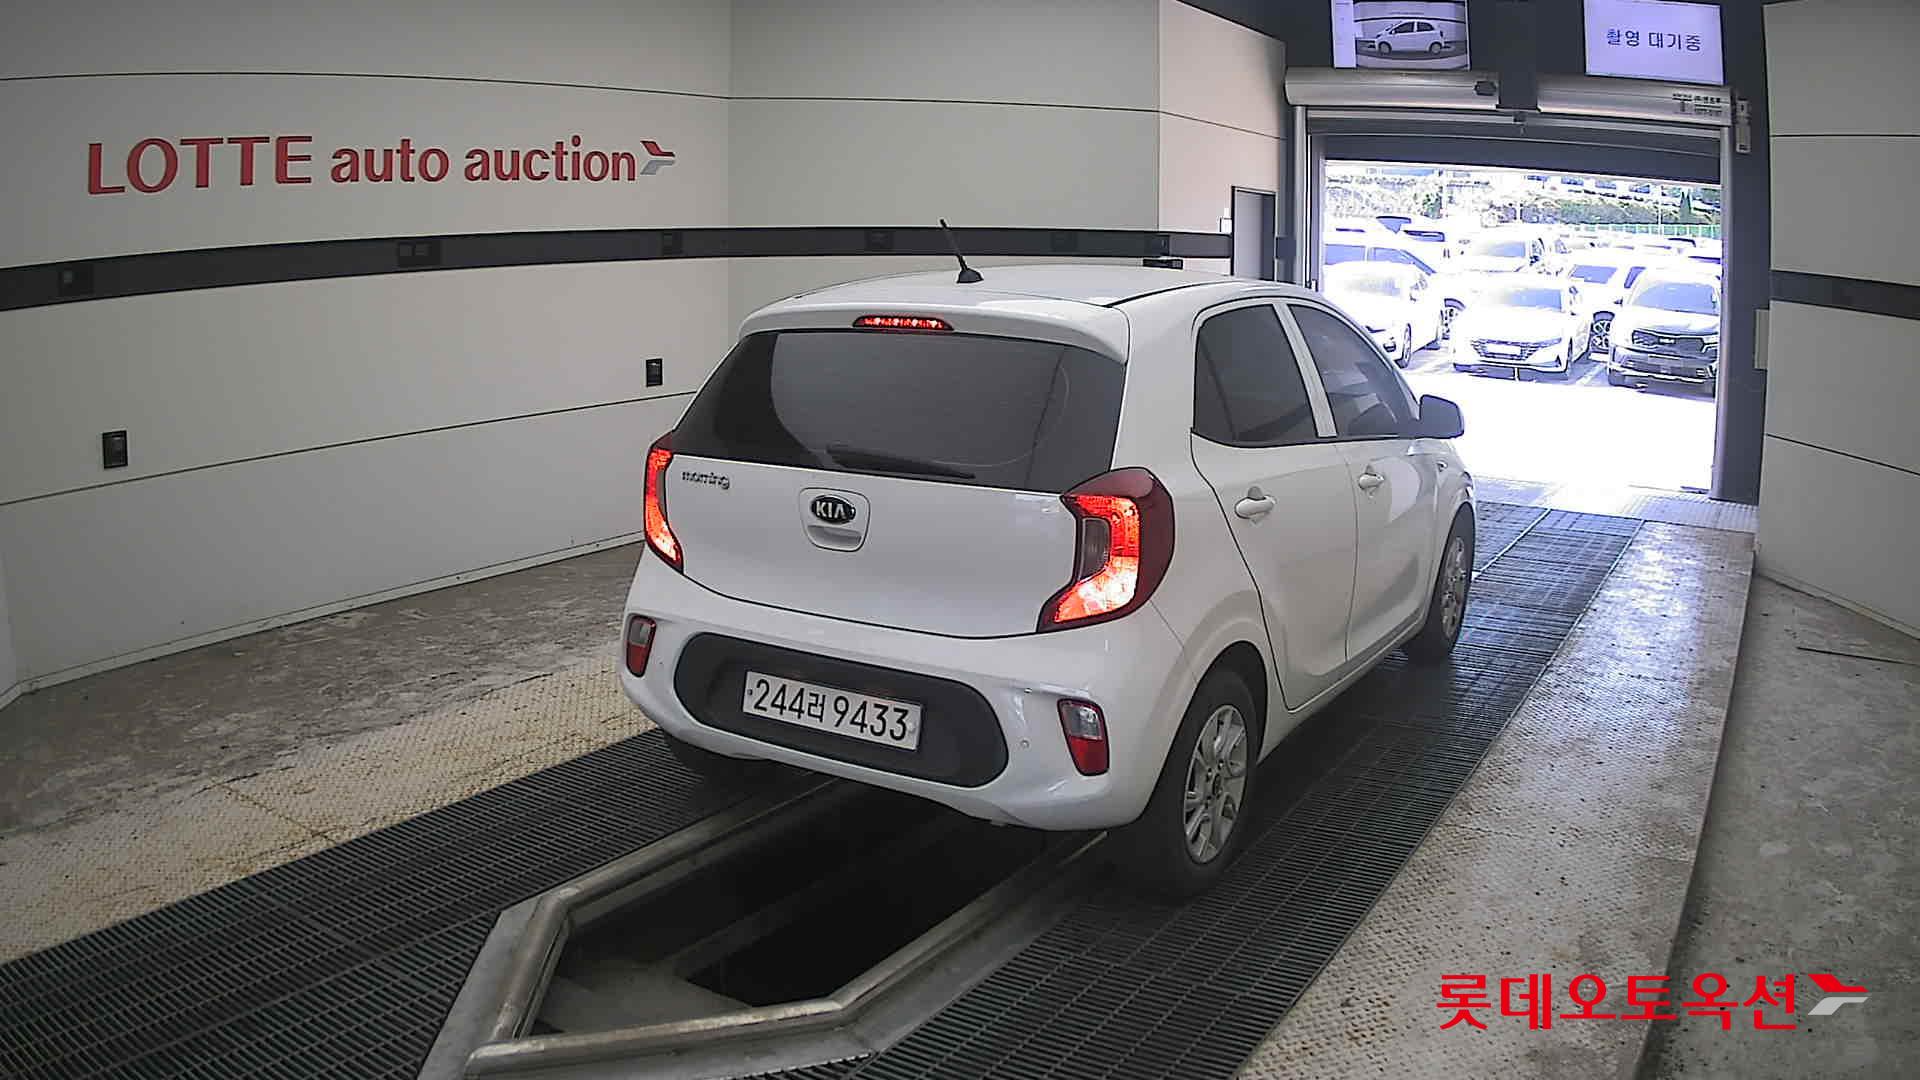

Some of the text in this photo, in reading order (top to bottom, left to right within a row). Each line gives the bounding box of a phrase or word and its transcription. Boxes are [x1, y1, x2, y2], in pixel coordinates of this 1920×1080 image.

[1607, 29, 1701, 51] 촬영 대기중
[88, 135, 636, 195] LOTTE auto auction
[815, 500, 847, 519] KIA
